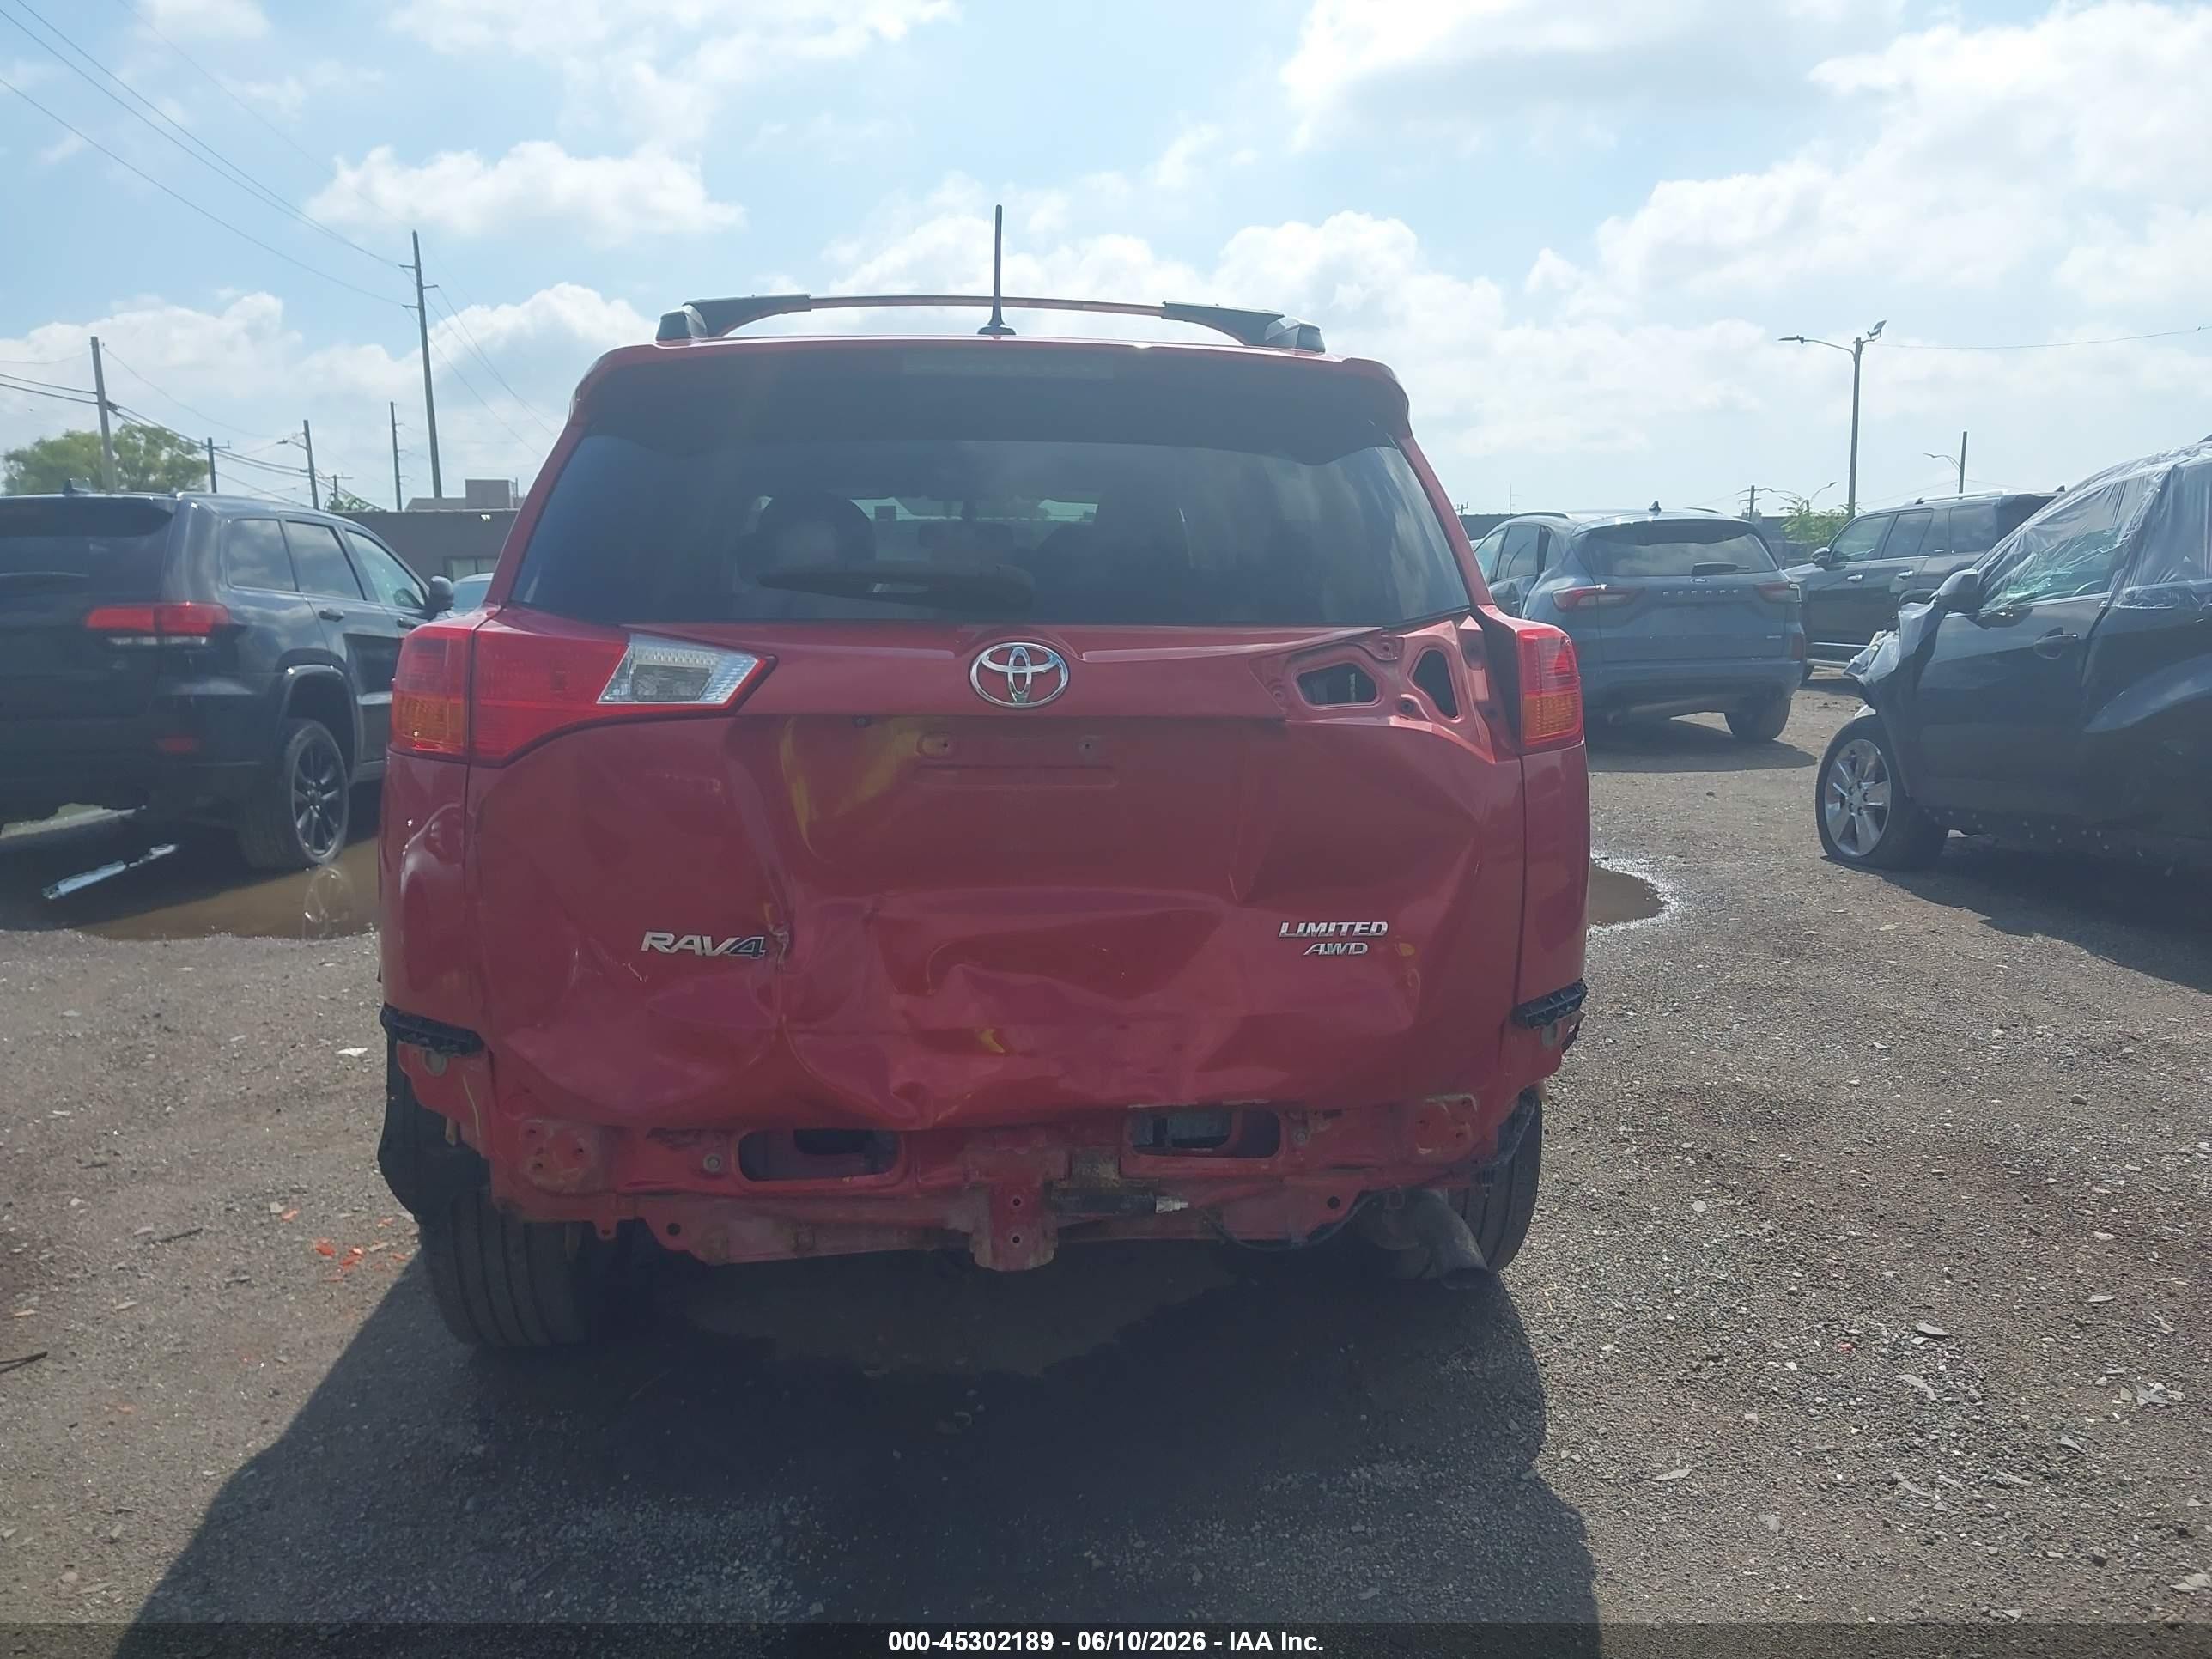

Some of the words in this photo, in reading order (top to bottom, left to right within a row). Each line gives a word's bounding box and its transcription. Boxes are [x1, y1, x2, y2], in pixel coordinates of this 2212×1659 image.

[1279, 921, 1388, 938] LIMITED
[641, 931, 767, 960] RAV4
[1304, 942, 1368, 956] AWD
